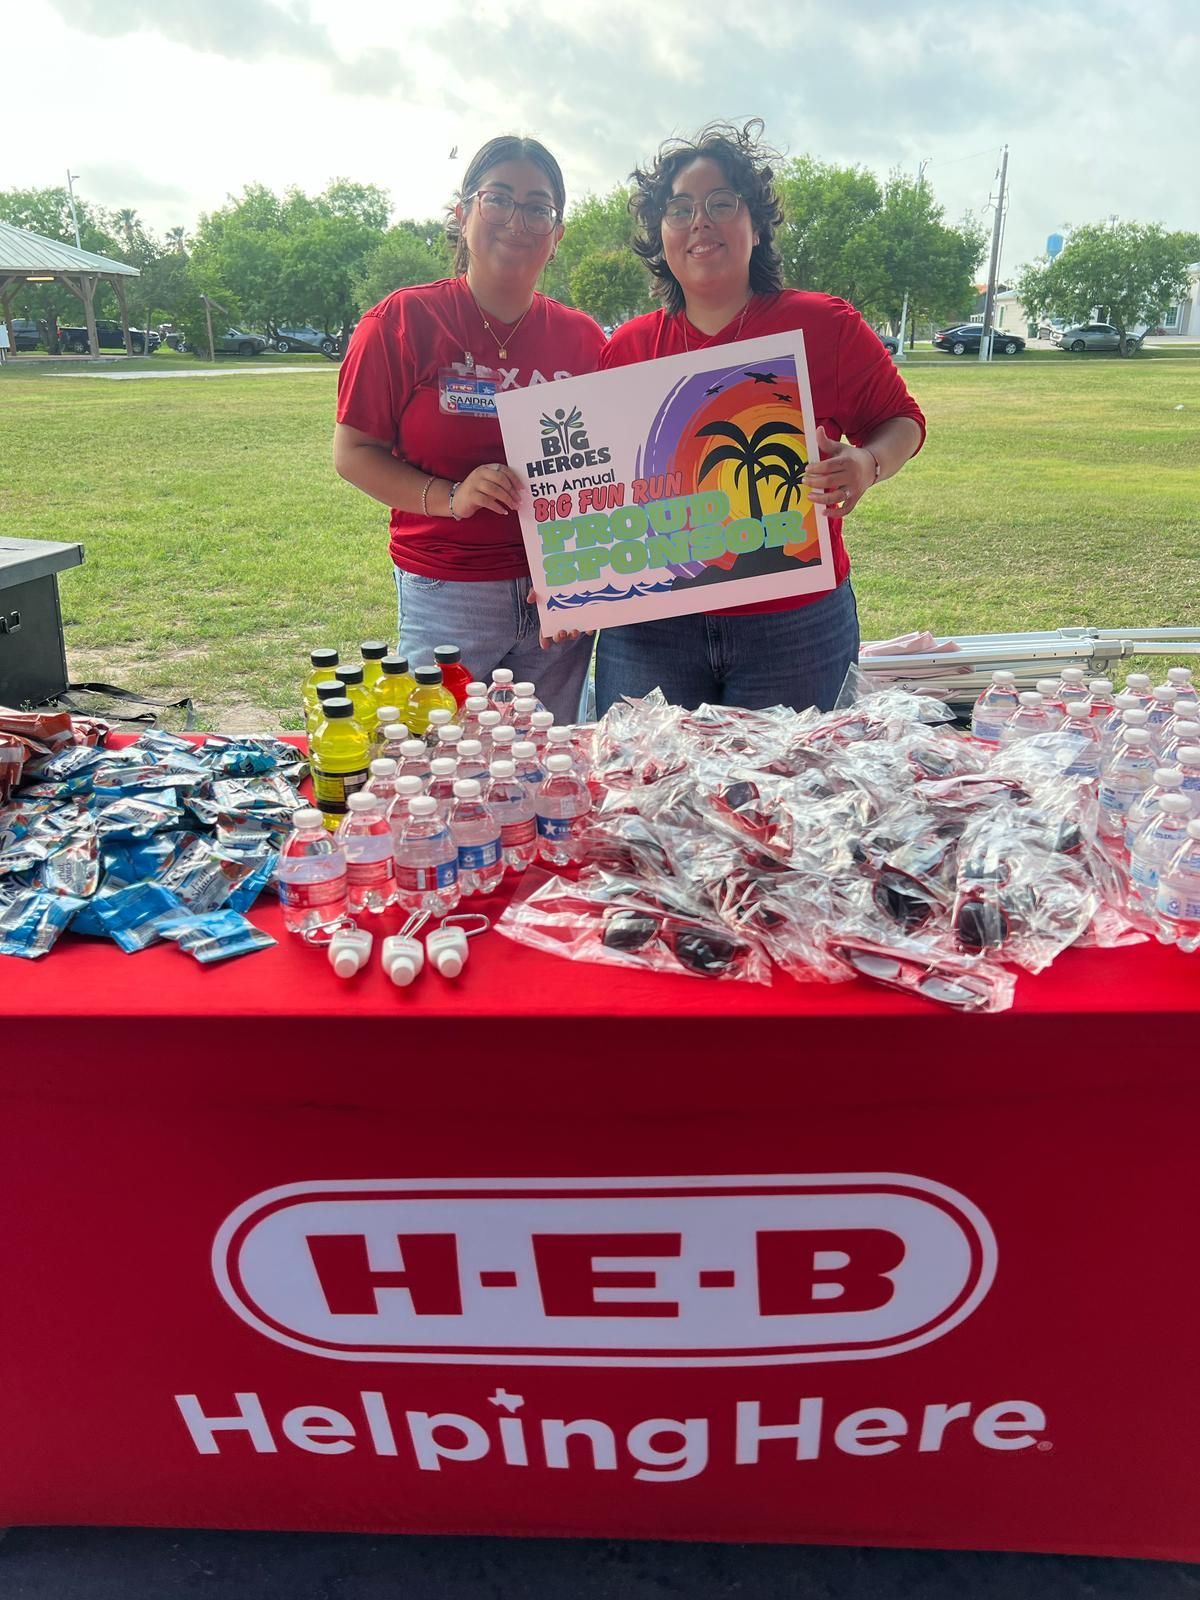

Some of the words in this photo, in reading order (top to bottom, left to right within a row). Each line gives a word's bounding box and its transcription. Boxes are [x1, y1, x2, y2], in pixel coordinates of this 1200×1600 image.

[449, 395, 495, 407] SANDRA
[526, 447, 612, 478] HEROES
[540, 428, 591, 458] BIG
[531, 482, 557, 498] 5th
[561, 468, 616, 492] Annual
[579, 483, 625, 514] FUN
[632, 471, 682, 504] RUN
[537, 489, 731, 555] PROUD
[543, 510, 807, 587] SPONSOR
[304, 1227, 906, 1318] H-E-B
[174, 1388, 711, 1483] Helping
